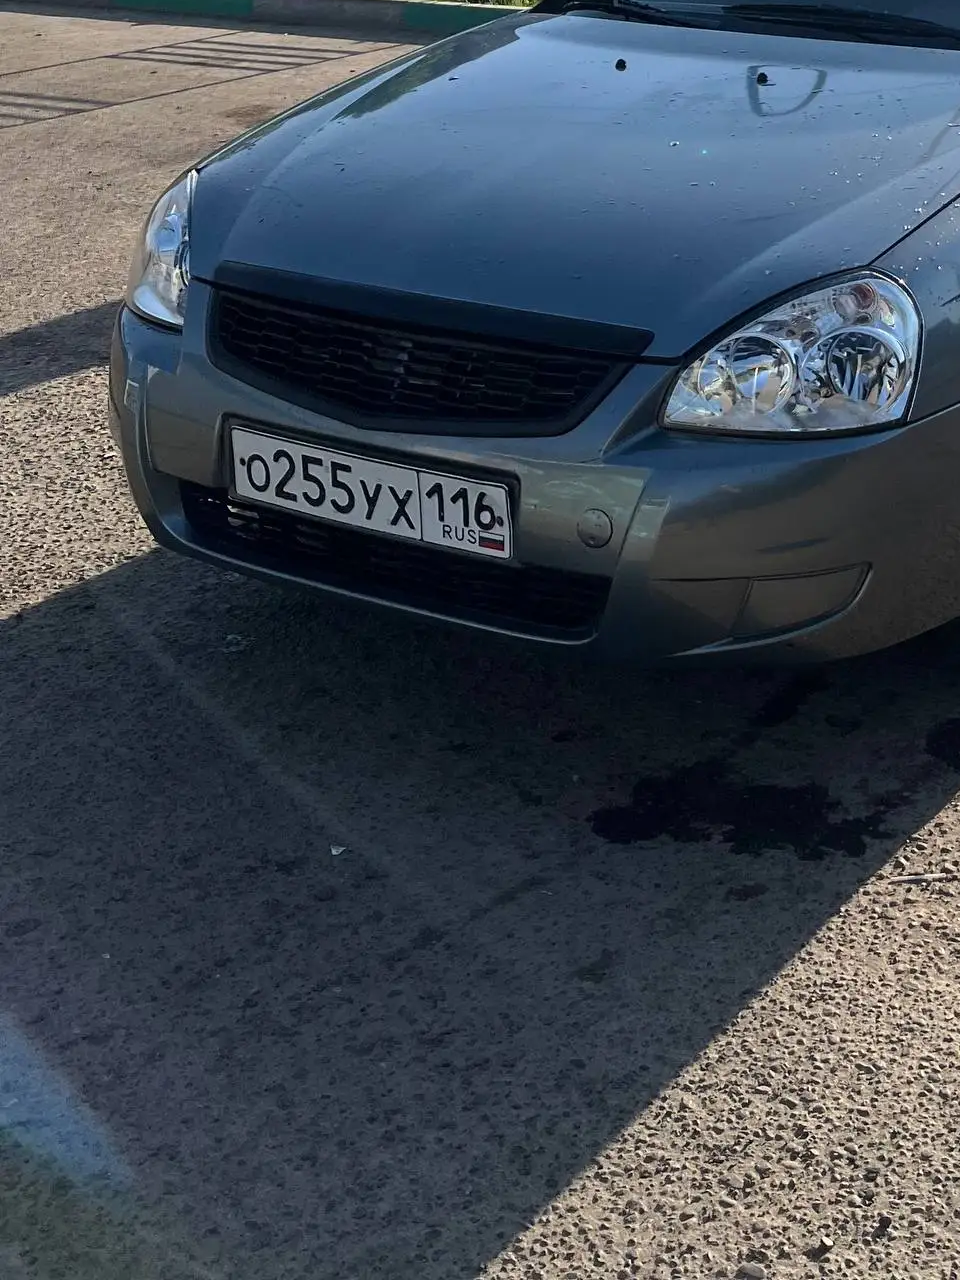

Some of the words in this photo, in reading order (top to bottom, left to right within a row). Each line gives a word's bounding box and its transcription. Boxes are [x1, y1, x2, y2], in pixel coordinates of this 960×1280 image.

[246, 449, 415, 530] О255УХ
[425, 482, 496, 530] 116
[443, 524, 477, 545] RUS
